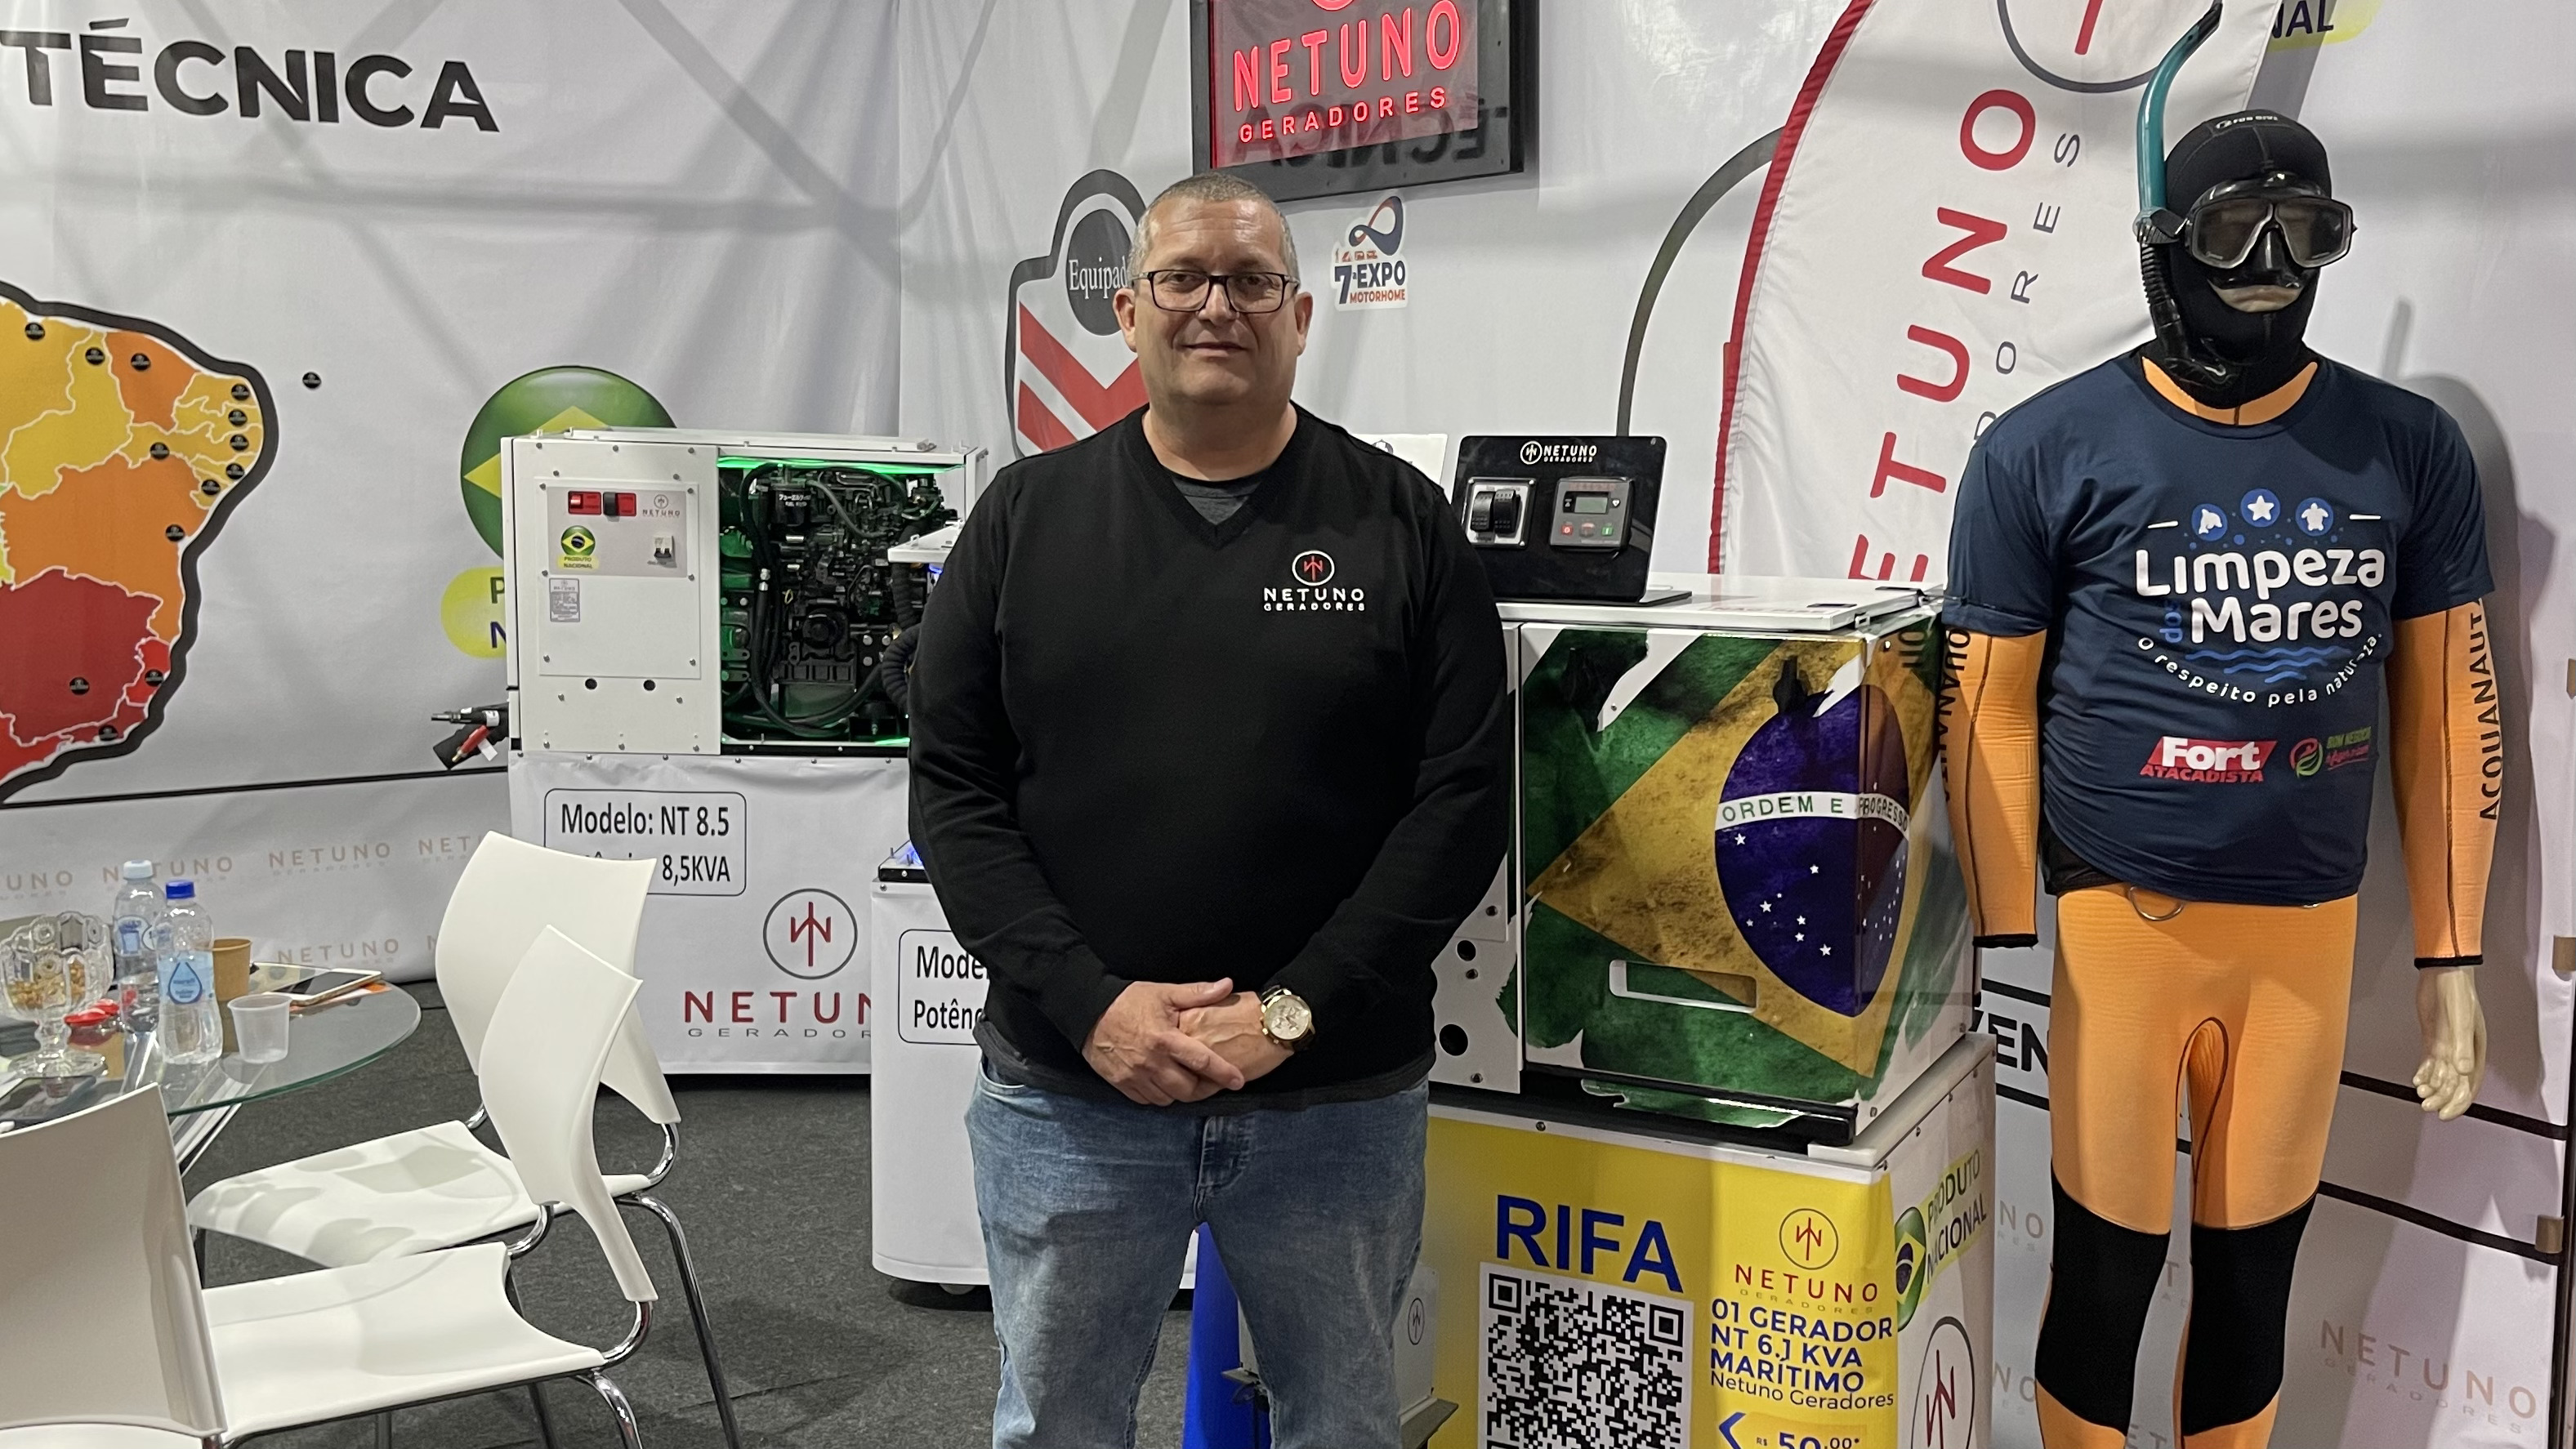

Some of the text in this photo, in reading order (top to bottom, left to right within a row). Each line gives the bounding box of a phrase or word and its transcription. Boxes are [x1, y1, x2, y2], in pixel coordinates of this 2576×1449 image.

[1233, 0, 1460, 112] NETUNO
[0, 18, 499, 133] TÉCNICA
[1238, 87, 1447, 144] GERADORES
[1357, 260, 1406, 288] EXPO
[1350, 288, 1406, 304] MOTORHOME
[1543, 444, 1597, 457] NETUNO
[2135, 547, 2386, 601] Limpeza
[1263, 587, 1364, 602] NETUNO
[1263, 602, 1365, 612] GERADORES
[2190, 595, 2364, 644] Mares
[2154, 653, 2257, 703] respeito
[2268, 688, 2318, 708] pela
[2469, 600, 2504, 821] ACQUANAUT
[2162, 735, 2261, 771] Fort
[2140, 764, 2265, 783] ATACADISTA
[561, 801, 730, 837] Modelo: NT 8.5
[1721, 795, 1814, 823] ORDEM
[1830, 797, 1843, 814] E
[269, 841, 391, 869] NETUNO
[418, 834, 483, 856] NET
[103, 856, 233, 883] NTUNO
[663, 854, 731, 887] 8,5KVA
[277, 939, 400, 964] NETUNO
[916, 945, 989, 980] Mode
[1495, 1194, 1684, 1294] RIFA
[1734, 1264, 1878, 1304] NETUNO
[1739, 1288, 1873, 1315] GERADORES
[1711, 1298, 1893, 1343] 01 GERADOR
[1711, 1322, 1864, 1368] NT 6.1 KVA
[1710, 1348, 1864, 1393] MARÍTIMO
[2320, 1319, 2537, 1419] NETUNO
[1711, 1370, 1895, 1410] Netuno Geradores
[2324, 1356, 2522, 1435] GERADORES
